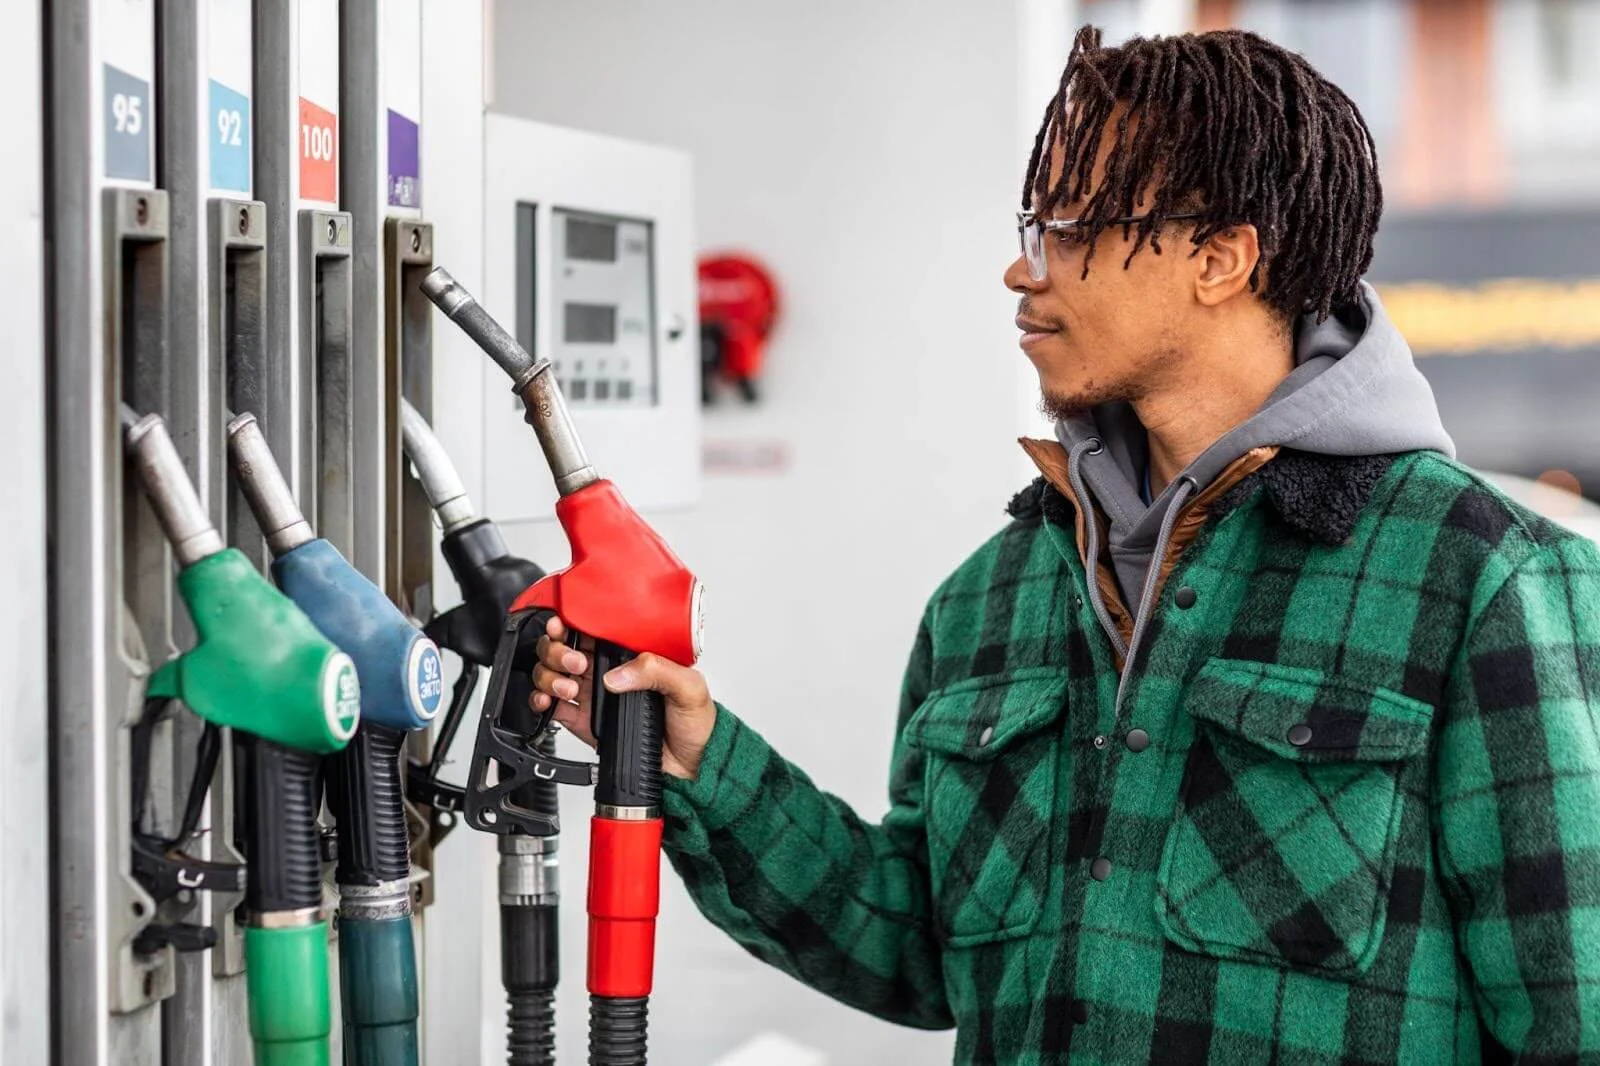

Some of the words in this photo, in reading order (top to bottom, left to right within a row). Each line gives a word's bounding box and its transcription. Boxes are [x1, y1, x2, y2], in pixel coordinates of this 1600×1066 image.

[113, 93, 142, 135] 95
[217, 109, 242, 146] 92
[302, 125, 333, 161] 100
[423, 655, 438, 681] 92
